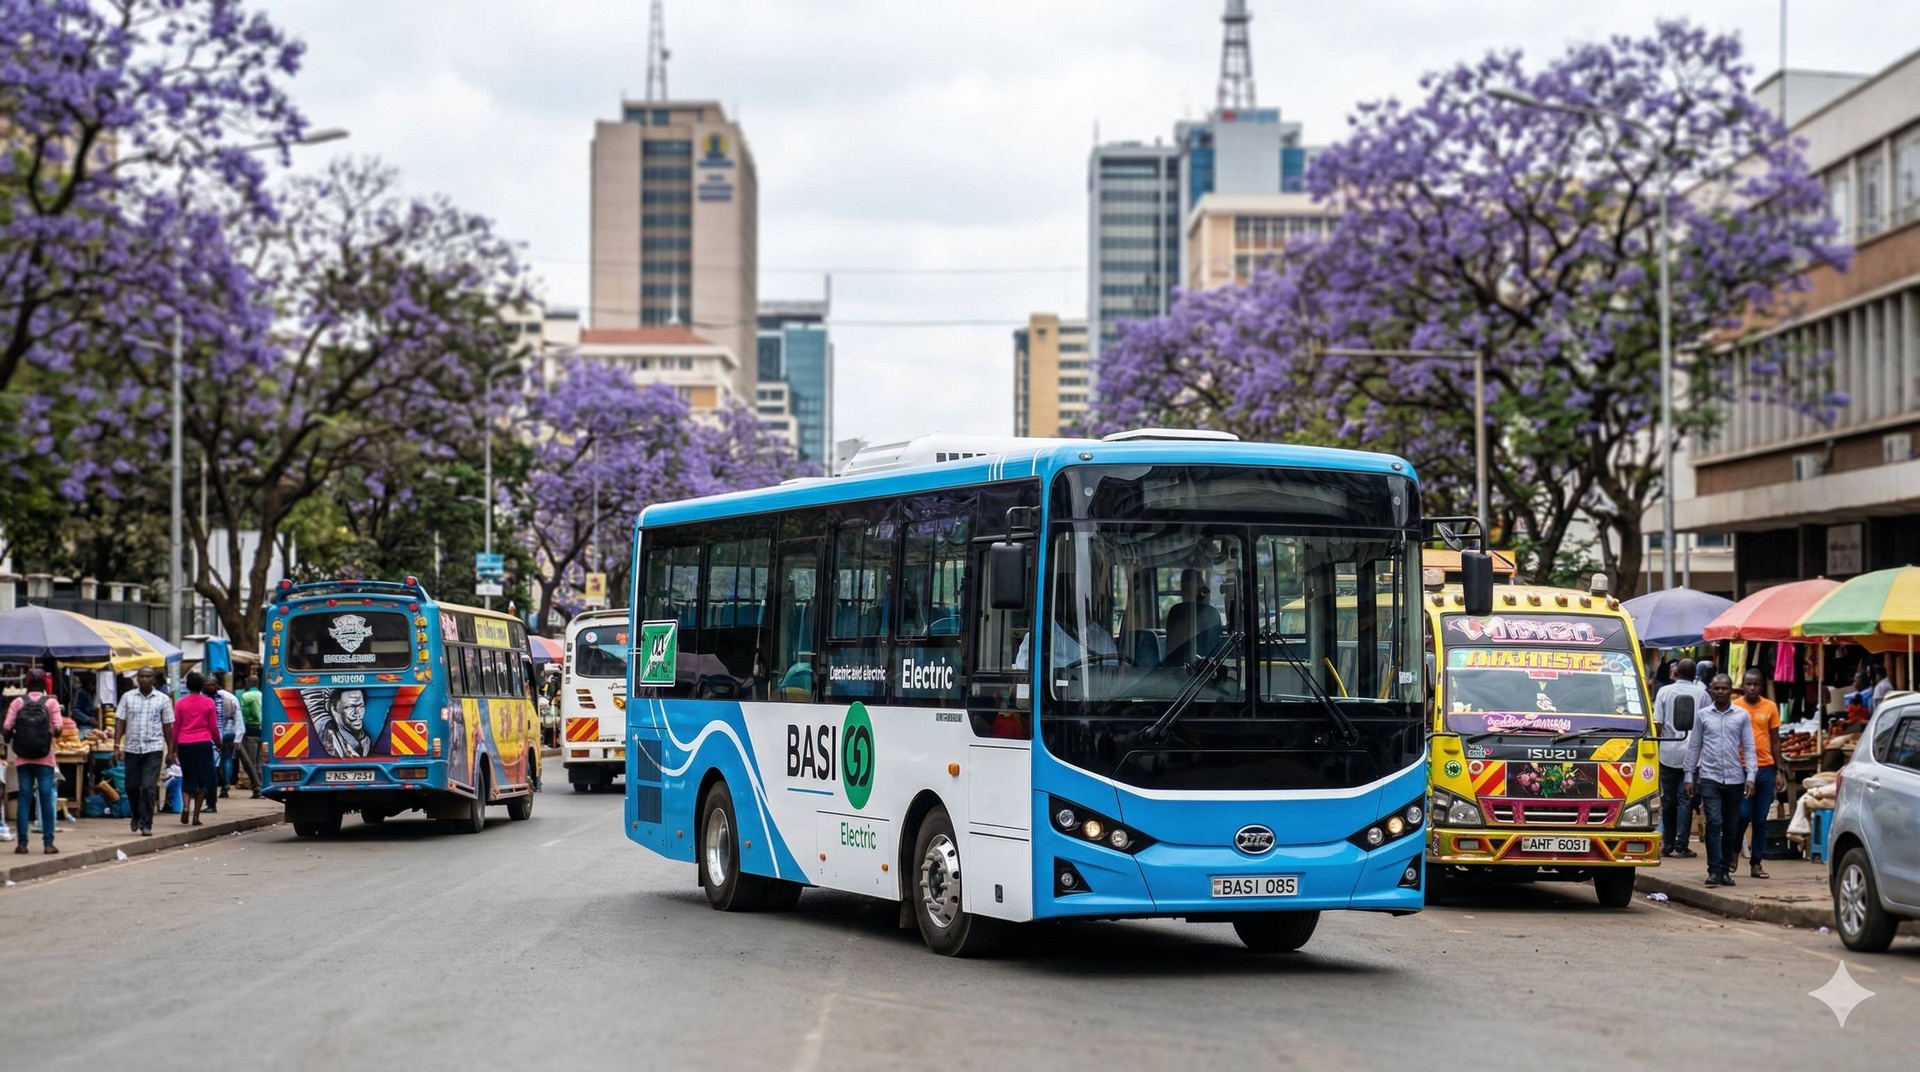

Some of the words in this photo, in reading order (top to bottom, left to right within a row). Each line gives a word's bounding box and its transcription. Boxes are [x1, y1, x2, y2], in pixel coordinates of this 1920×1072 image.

[902, 656, 953, 690] Electric
[787, 724, 836, 780] BASI
[1528, 748, 1576, 760] ISUZU
[841, 821, 876, 850] Electric
[1222, 879, 1259, 895] BASI
[1265, 879, 1295, 894] 085
